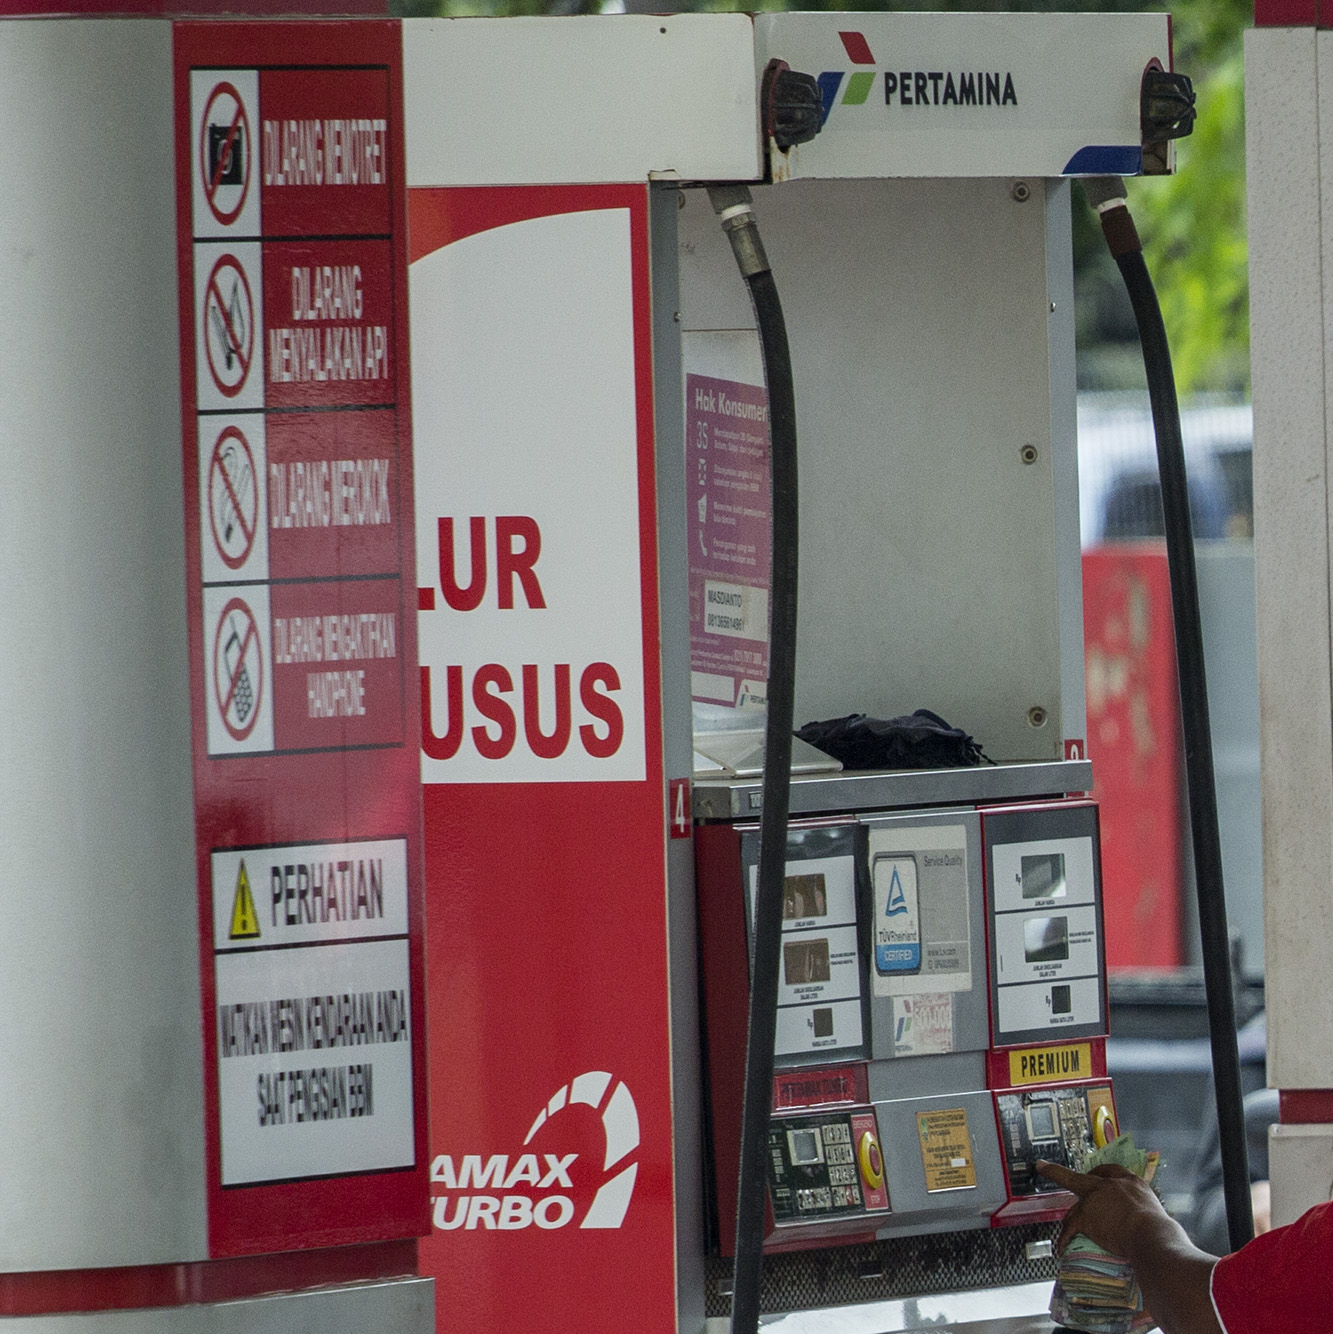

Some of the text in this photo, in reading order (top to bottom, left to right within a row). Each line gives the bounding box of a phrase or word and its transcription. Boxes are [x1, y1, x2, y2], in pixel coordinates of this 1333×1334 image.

[883, 71, 1018, 106] PERTAMINA
[292, 265, 363, 320] DILARANG
[365, 326, 388, 379] API
[695, 388, 717, 413] Hak
[419, 661, 624, 760] USUS
[675, 783, 686, 833] 4
[924, 854, 962, 867] Service Quality
[271, 859, 384, 927] PERHATIAN
[884, 950, 912, 961] CERTIFIED
[1021, 1050, 1079, 1077] PREMIUM
[348, 1063, 375, 1117] BBM
[430, 1153, 579, 1188] AMAX
